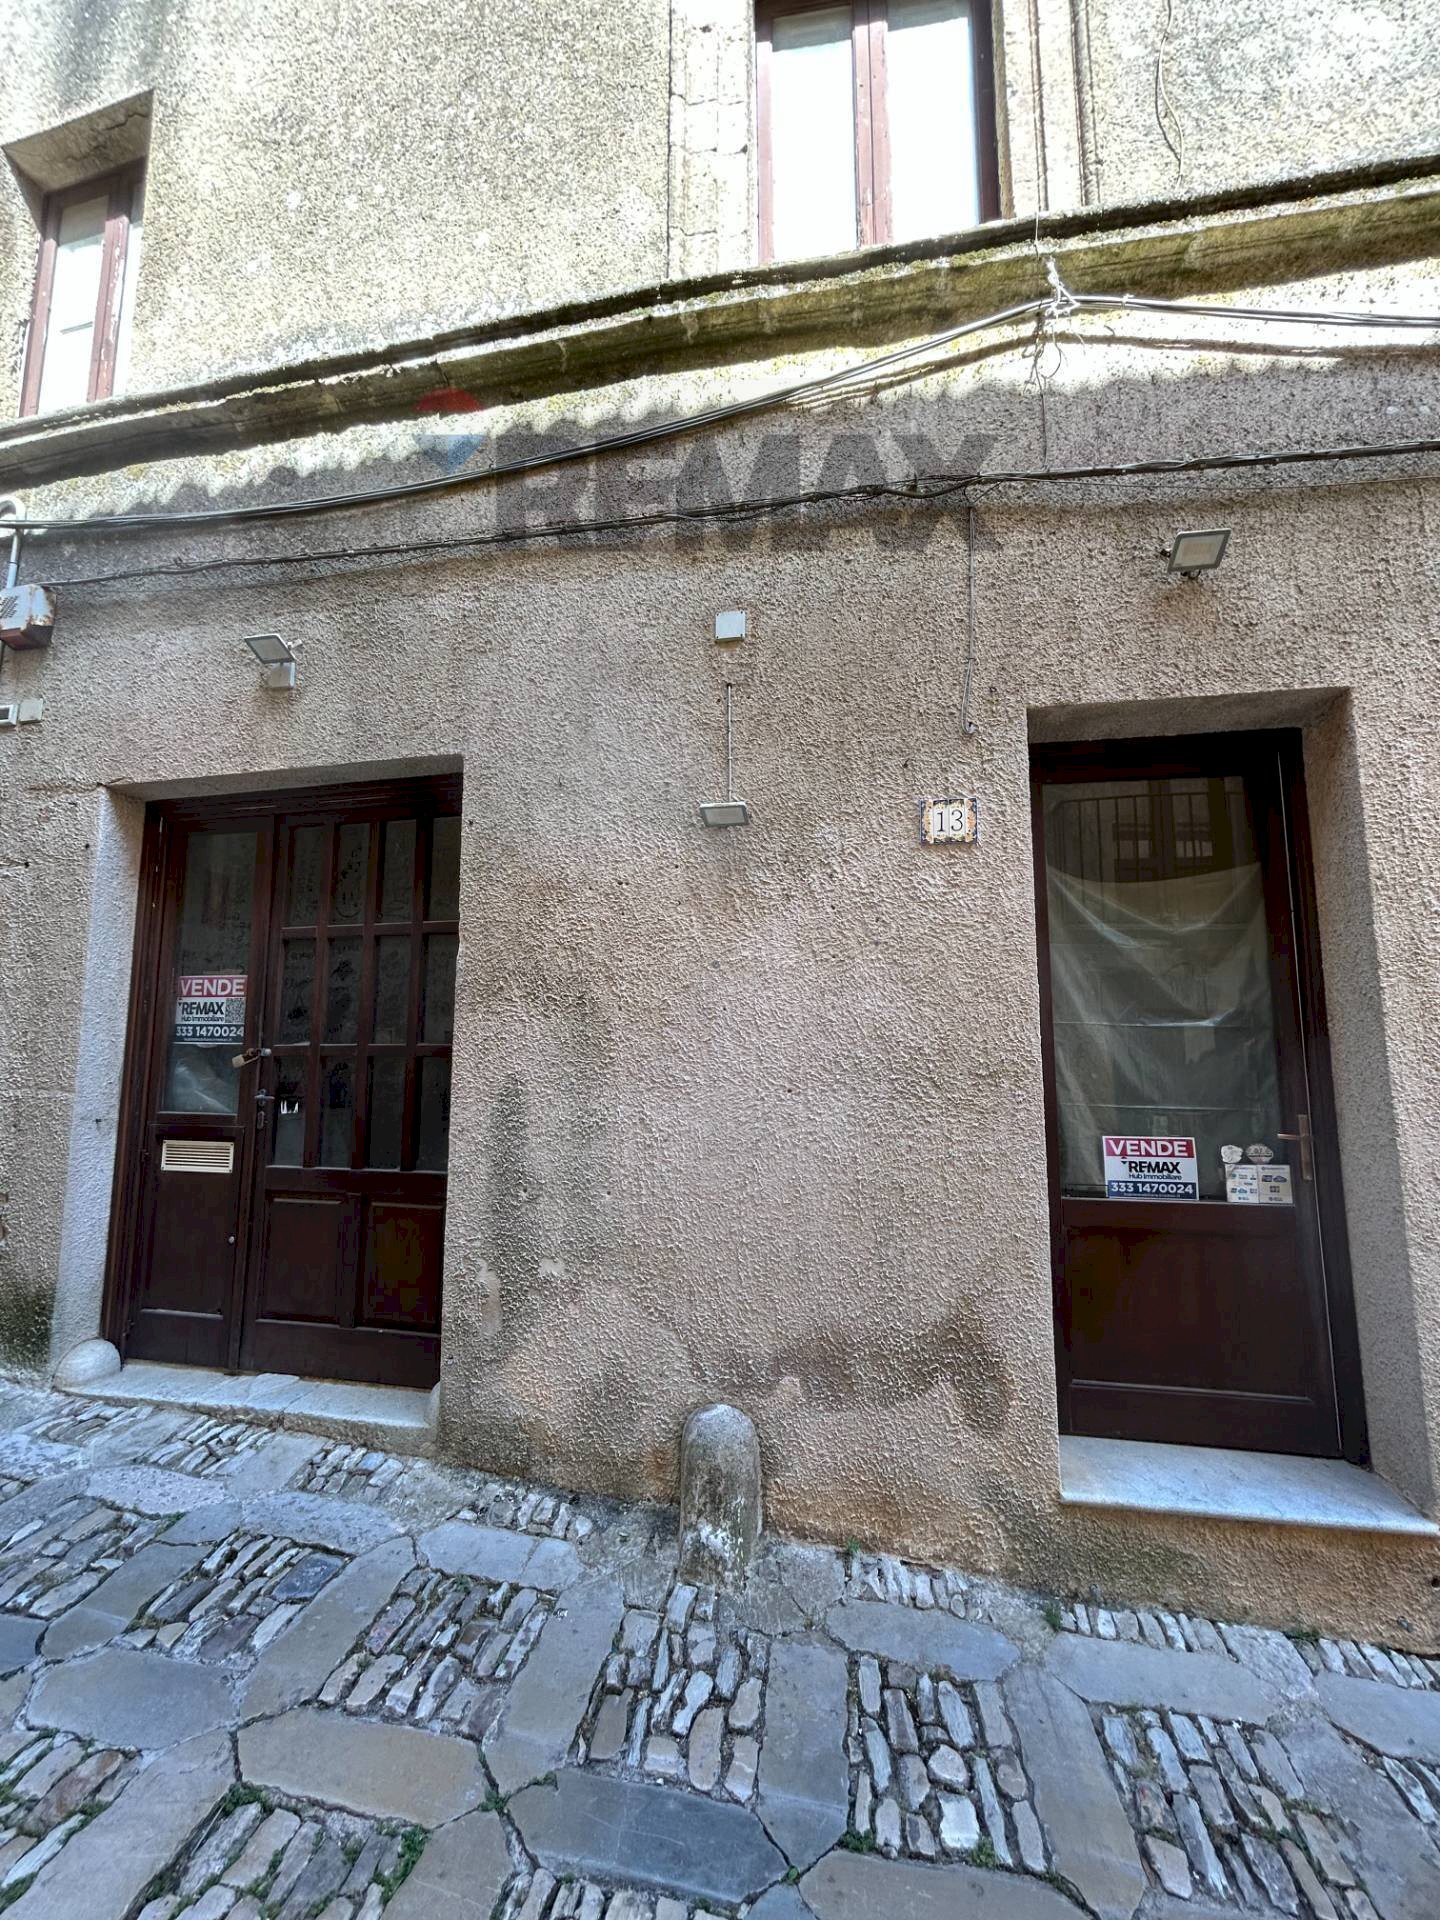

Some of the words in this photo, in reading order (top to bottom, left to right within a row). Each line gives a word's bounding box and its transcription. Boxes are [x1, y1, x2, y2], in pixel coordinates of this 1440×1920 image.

[936, 808, 964, 833] 13
[180, 979, 245, 995] VENDE
[176, 1026, 193, 1037] 333
[195, 1026, 244, 1037] 1470024
[1107, 1139, 1189, 1157] VENDE
[1111, 1182, 1134, 1192] 333
[1136, 1183, 1194, 1194] 1470024
